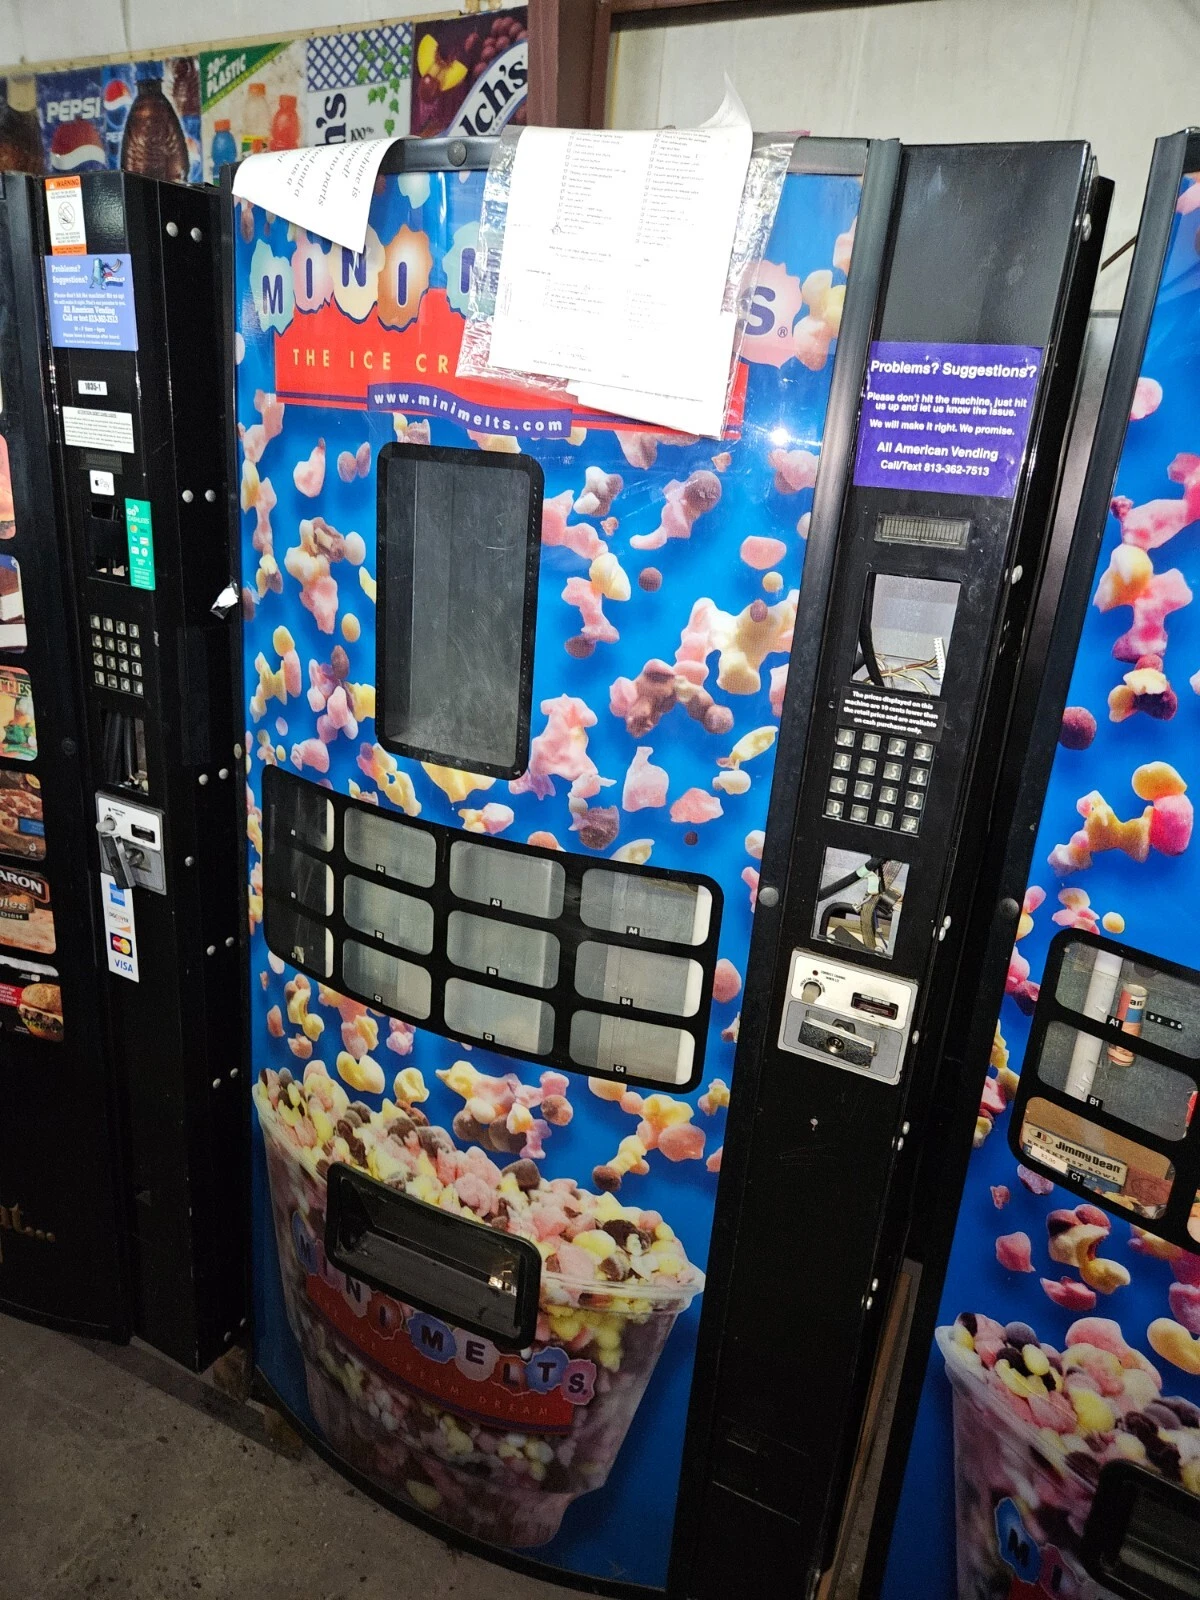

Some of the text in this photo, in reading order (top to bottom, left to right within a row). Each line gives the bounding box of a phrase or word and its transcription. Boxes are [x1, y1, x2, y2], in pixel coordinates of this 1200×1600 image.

[206, 53, 247, 99] PLASTIC
[47, 97, 101, 123] PEPSI
[57, 179, 80, 187] WARNING
[318, 171, 332, 207] parts
[52, 265, 81, 273] Problems?
[53, 276, 88, 285] Suggestions?
[63, 314, 73, 322] Call
[72, 306, 95, 314] American
[95, 306, 115, 316] Vending
[293, 348, 331, 368] THE
[350, 351, 392, 371] ICE
[871, 360, 1037, 379] Problems? Suggestions?
[867, 392, 1028, 408] Please don't hit the machine, just hit
[374, 392, 563, 432] www.minimelts.com
[888, 404, 899, 412] up
[901, 403, 918, 412] and
[920, 404, 931, 413] let
[933, 406, 944, 414] us
[946, 405, 970, 414] know
[972, 406, 988, 415] the
[989, 406, 1017, 417] issue.
[870, 419, 1015, 436] We will make it right. We promise.
[877, 442, 999, 462] All American Vending
[881, 460, 990, 476] Call/Text 813-362-7513
[127, 508, 137, 516] GO
[127, 516, 150, 525] CASHLESS
[853, 691, 864, 699] The
[864, 694, 883, 702] prices
[883, 696, 912, 707] displayed
[921, 702, 934, 710] this
[845, 699, 870, 708] machine
[889, 706, 906, 714] cents
[906, 708, 923, 717] lower
[924, 712, 939, 720] than
[854, 709, 870, 717] retail
[870, 711, 886, 719] price
[886, 714, 898, 722] and
[909, 718, 937, 728] available
[876, 721, 907, 732] purchases
[907, 726, 923, 735] only.
[0, 870, 42, 894] ARON
[492, 899, 500, 907] A3
[109, 912, 129, 923] DISCOVER
[629, 927, 638, 935] A4
[115, 960, 134, 974] VISA
[622, 998, 631, 1006] B4
[1109, 1018, 1120, 1028] A1
[1090, 1097, 1100, 1107] B1
[1027, 1139, 1084, 1168] BREAKFAST
[1088, 1167, 1119, 1182] BOWL
[1056, 1141, 1121, 1174] Jimmy Dean
[1071, 1173, 1081, 1183] C1
[421, 1326, 586, 1394] MELTS
[478, 1394, 549, 1417] DREAM
